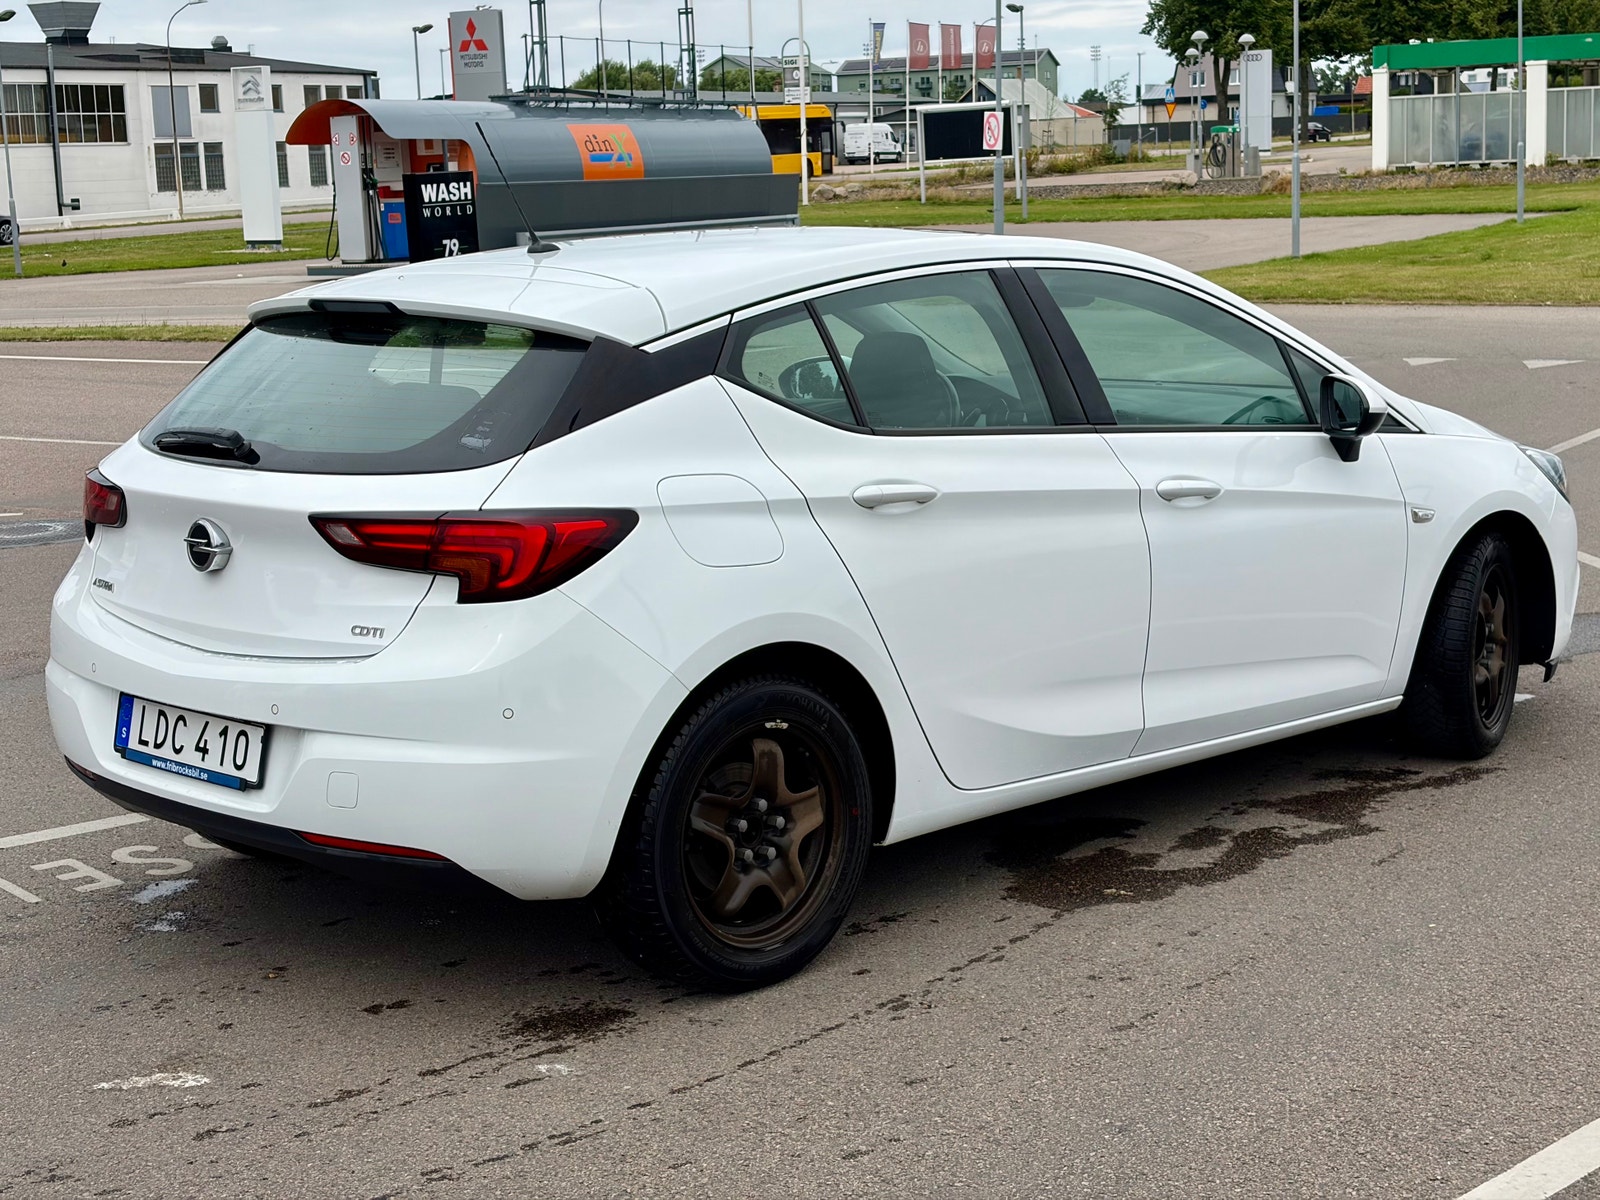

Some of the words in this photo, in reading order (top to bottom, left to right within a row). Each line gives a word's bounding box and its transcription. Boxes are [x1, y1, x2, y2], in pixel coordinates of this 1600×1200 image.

[460, 53, 488, 61] MITSUBISHI
[463, 61, 484, 69] MOTORS
[421, 181, 472, 203] WASH
[422, 204, 473, 218] WORLD
[442, 238, 459, 257] 79
[351, 624, 385, 639] CDTI
[121, 727, 127, 738] S
[138, 705, 187, 755] LDC
[194, 720, 249, 771] 410
[151, 758, 208, 780] www.fribrocksbil.se
